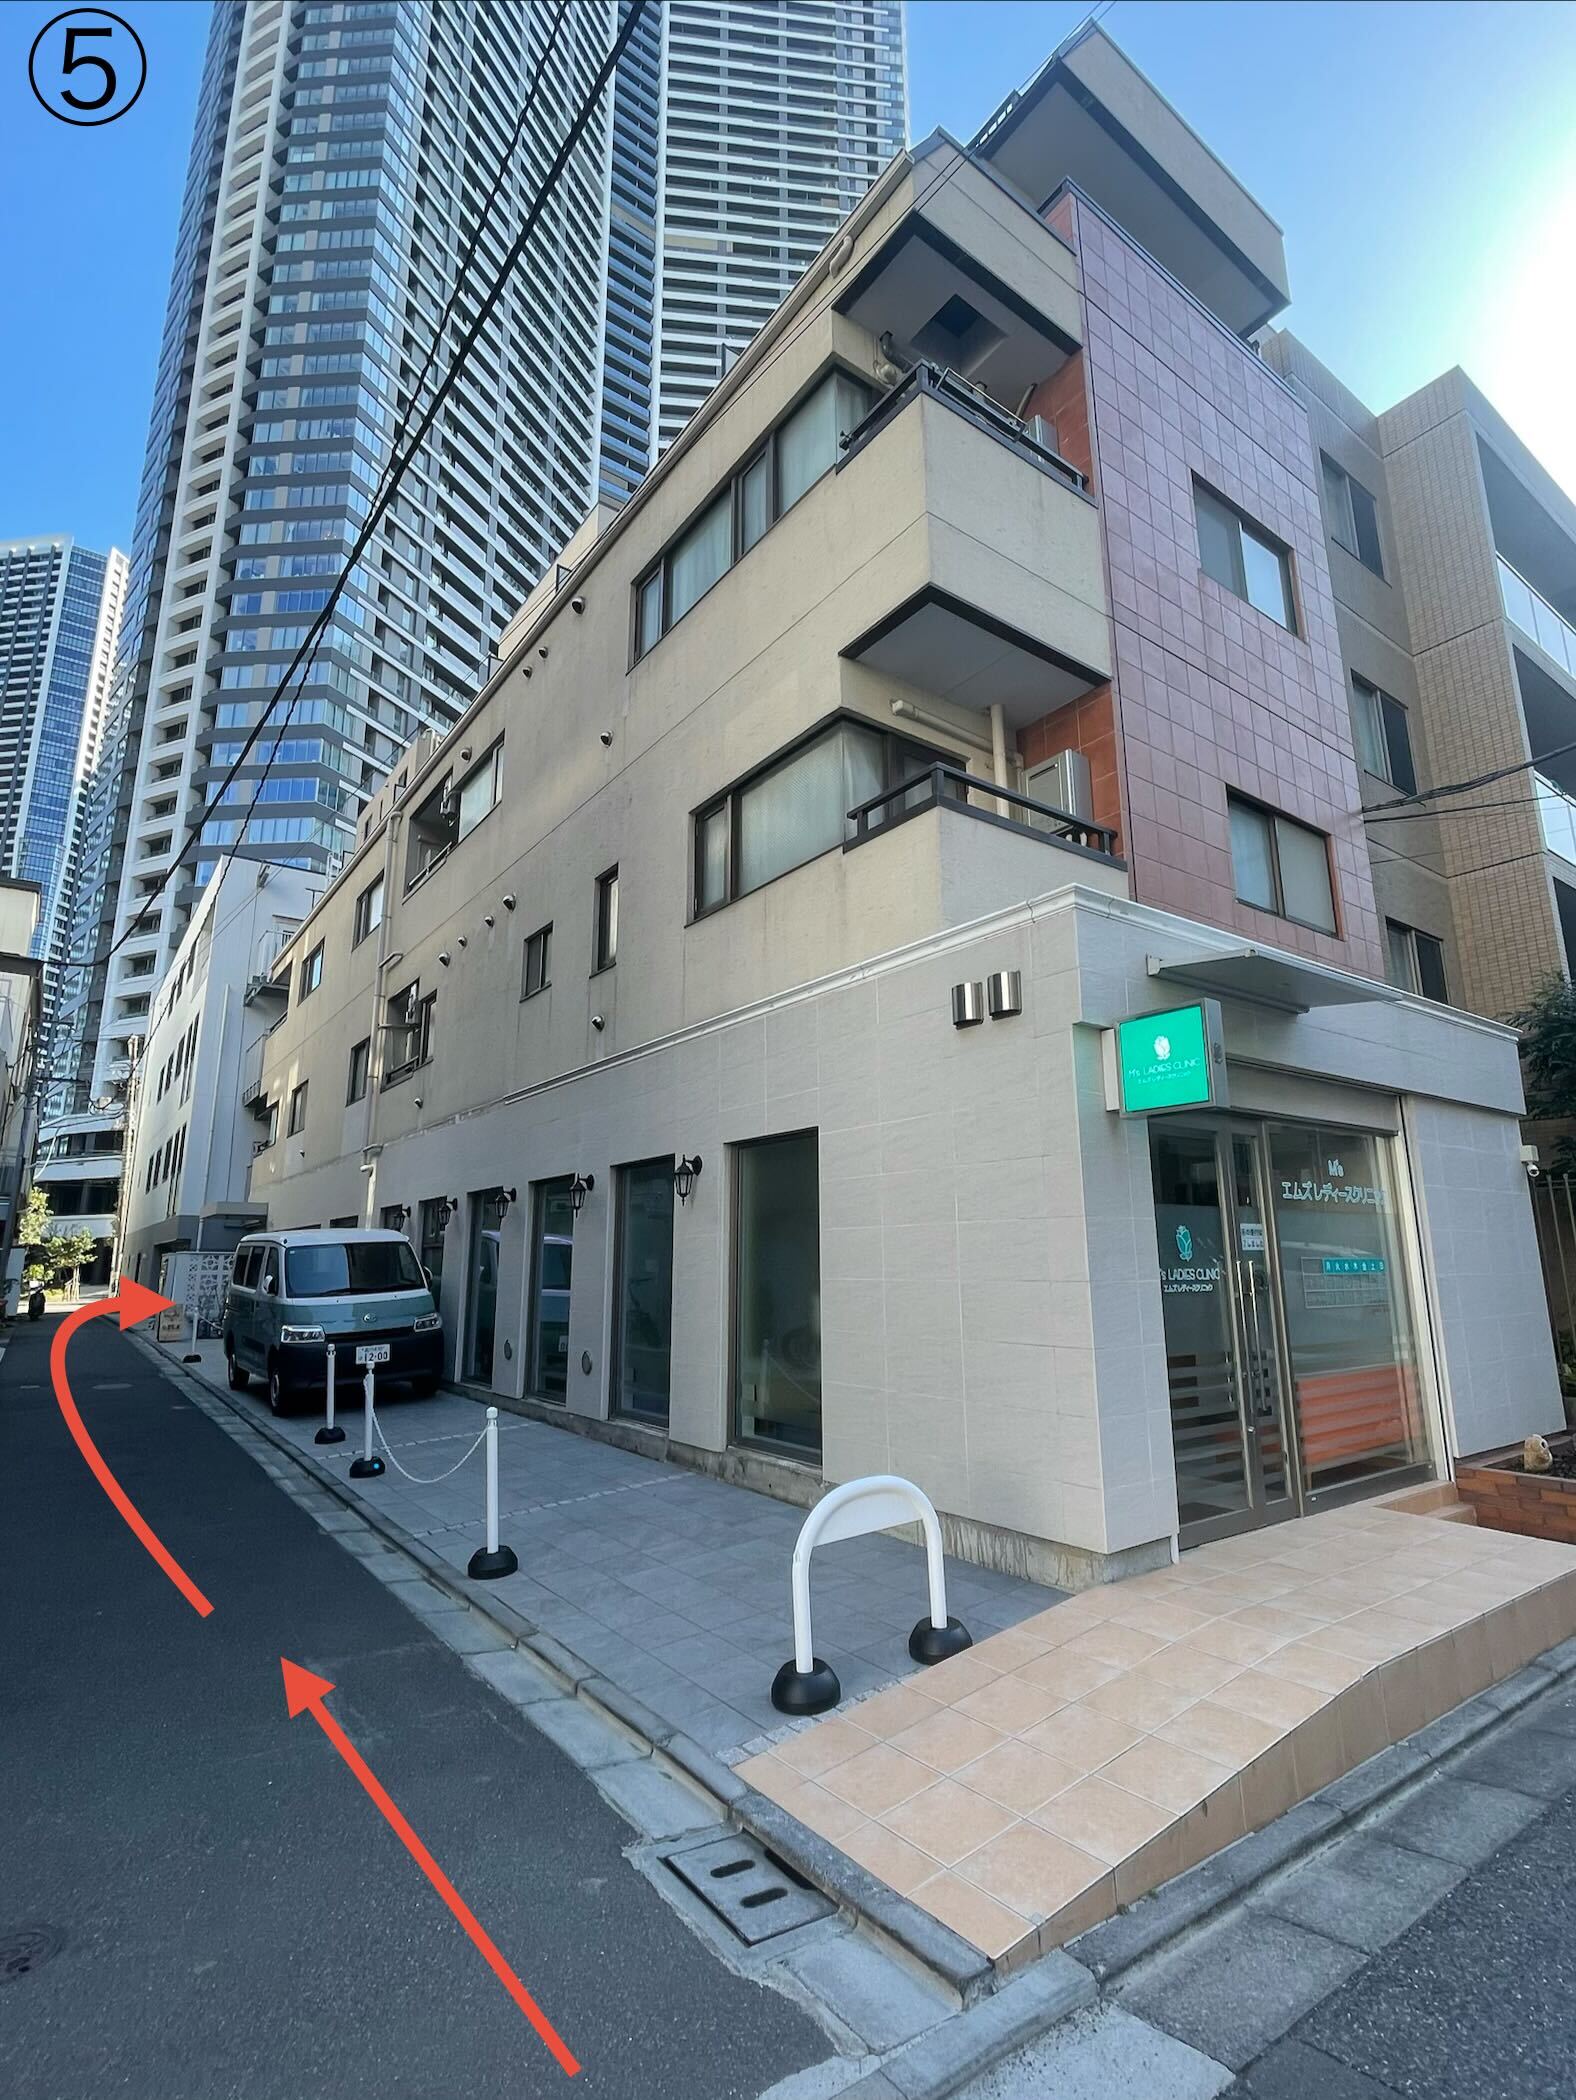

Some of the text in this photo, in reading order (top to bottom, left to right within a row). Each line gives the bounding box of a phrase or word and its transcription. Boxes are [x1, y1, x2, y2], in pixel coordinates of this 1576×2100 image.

[1143, 1062, 1172, 1075] LADIES
[1172, 1057, 1201, 1070] CLINIC
[1327, 1159, 1345, 1177] M's
[1167, 1268, 1196, 1281] LADIES
[1196, 1268, 1220, 1281] CLINIC
